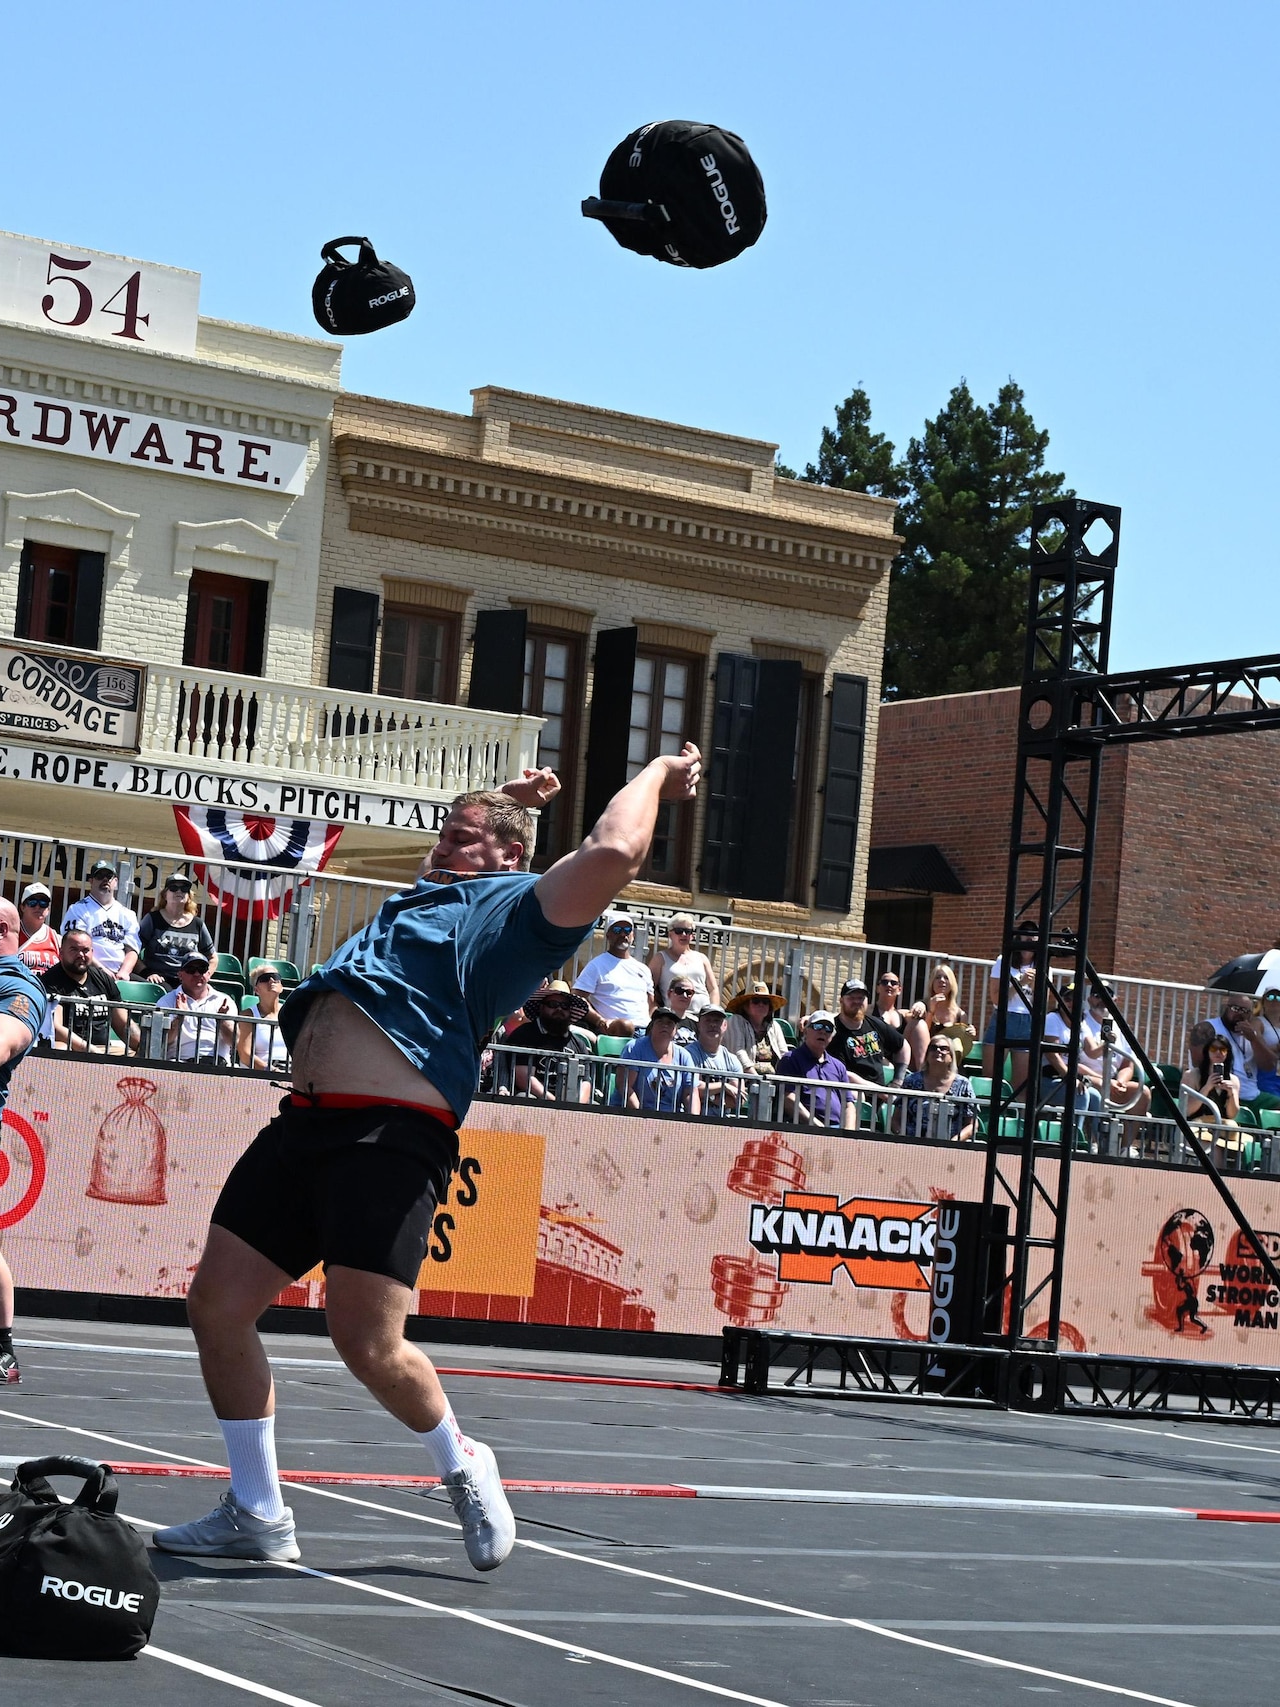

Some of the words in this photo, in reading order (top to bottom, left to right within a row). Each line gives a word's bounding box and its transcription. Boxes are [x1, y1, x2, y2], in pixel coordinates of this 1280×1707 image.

[700, 153, 741, 236] ROGUE
[41, 252, 150, 342] 54
[368, 285, 410, 309] ROGUE
[7, 655, 120, 736] CORDAGE
[105, 676, 126, 691] 156
[14, 716, 59, 731] PRICES
[31, 752, 118, 792] ROPE,
[129, 765, 270, 814] BLOCKS,
[280, 785, 372, 825] PITCH,
[750, 1206, 937, 1257] KNAACK
[1220, 1262, 1279, 1286] WORL
[1234, 1309, 1278, 1330] MAN
[40, 1574, 144, 1614] ROGUE
